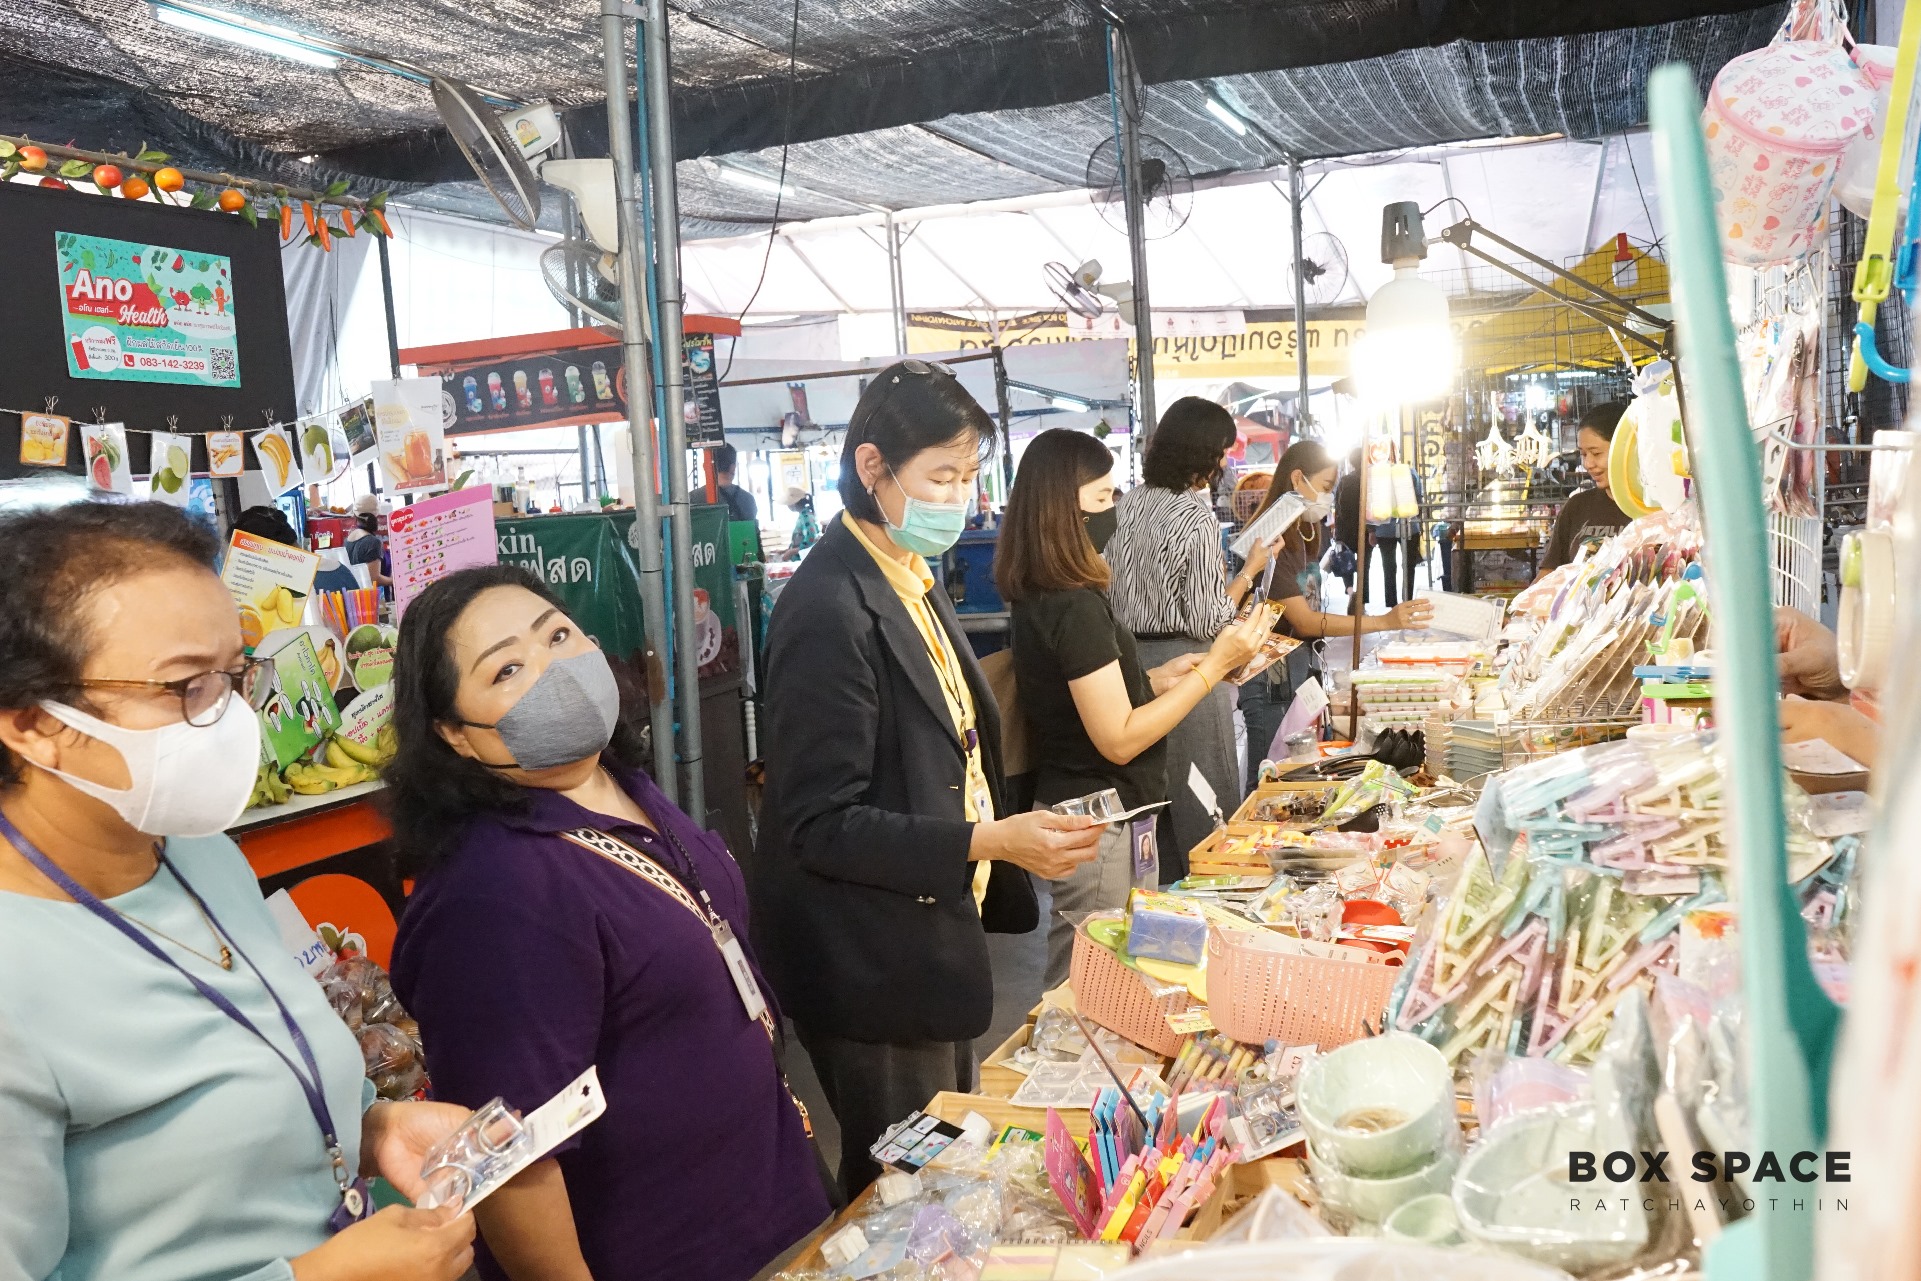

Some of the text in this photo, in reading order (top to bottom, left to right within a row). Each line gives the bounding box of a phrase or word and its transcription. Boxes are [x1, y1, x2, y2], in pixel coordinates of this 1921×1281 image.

[72, 268, 133, 302] Ano
[118, 304, 168, 327] Health
[140, 357, 205, 371] 083-142-3239
